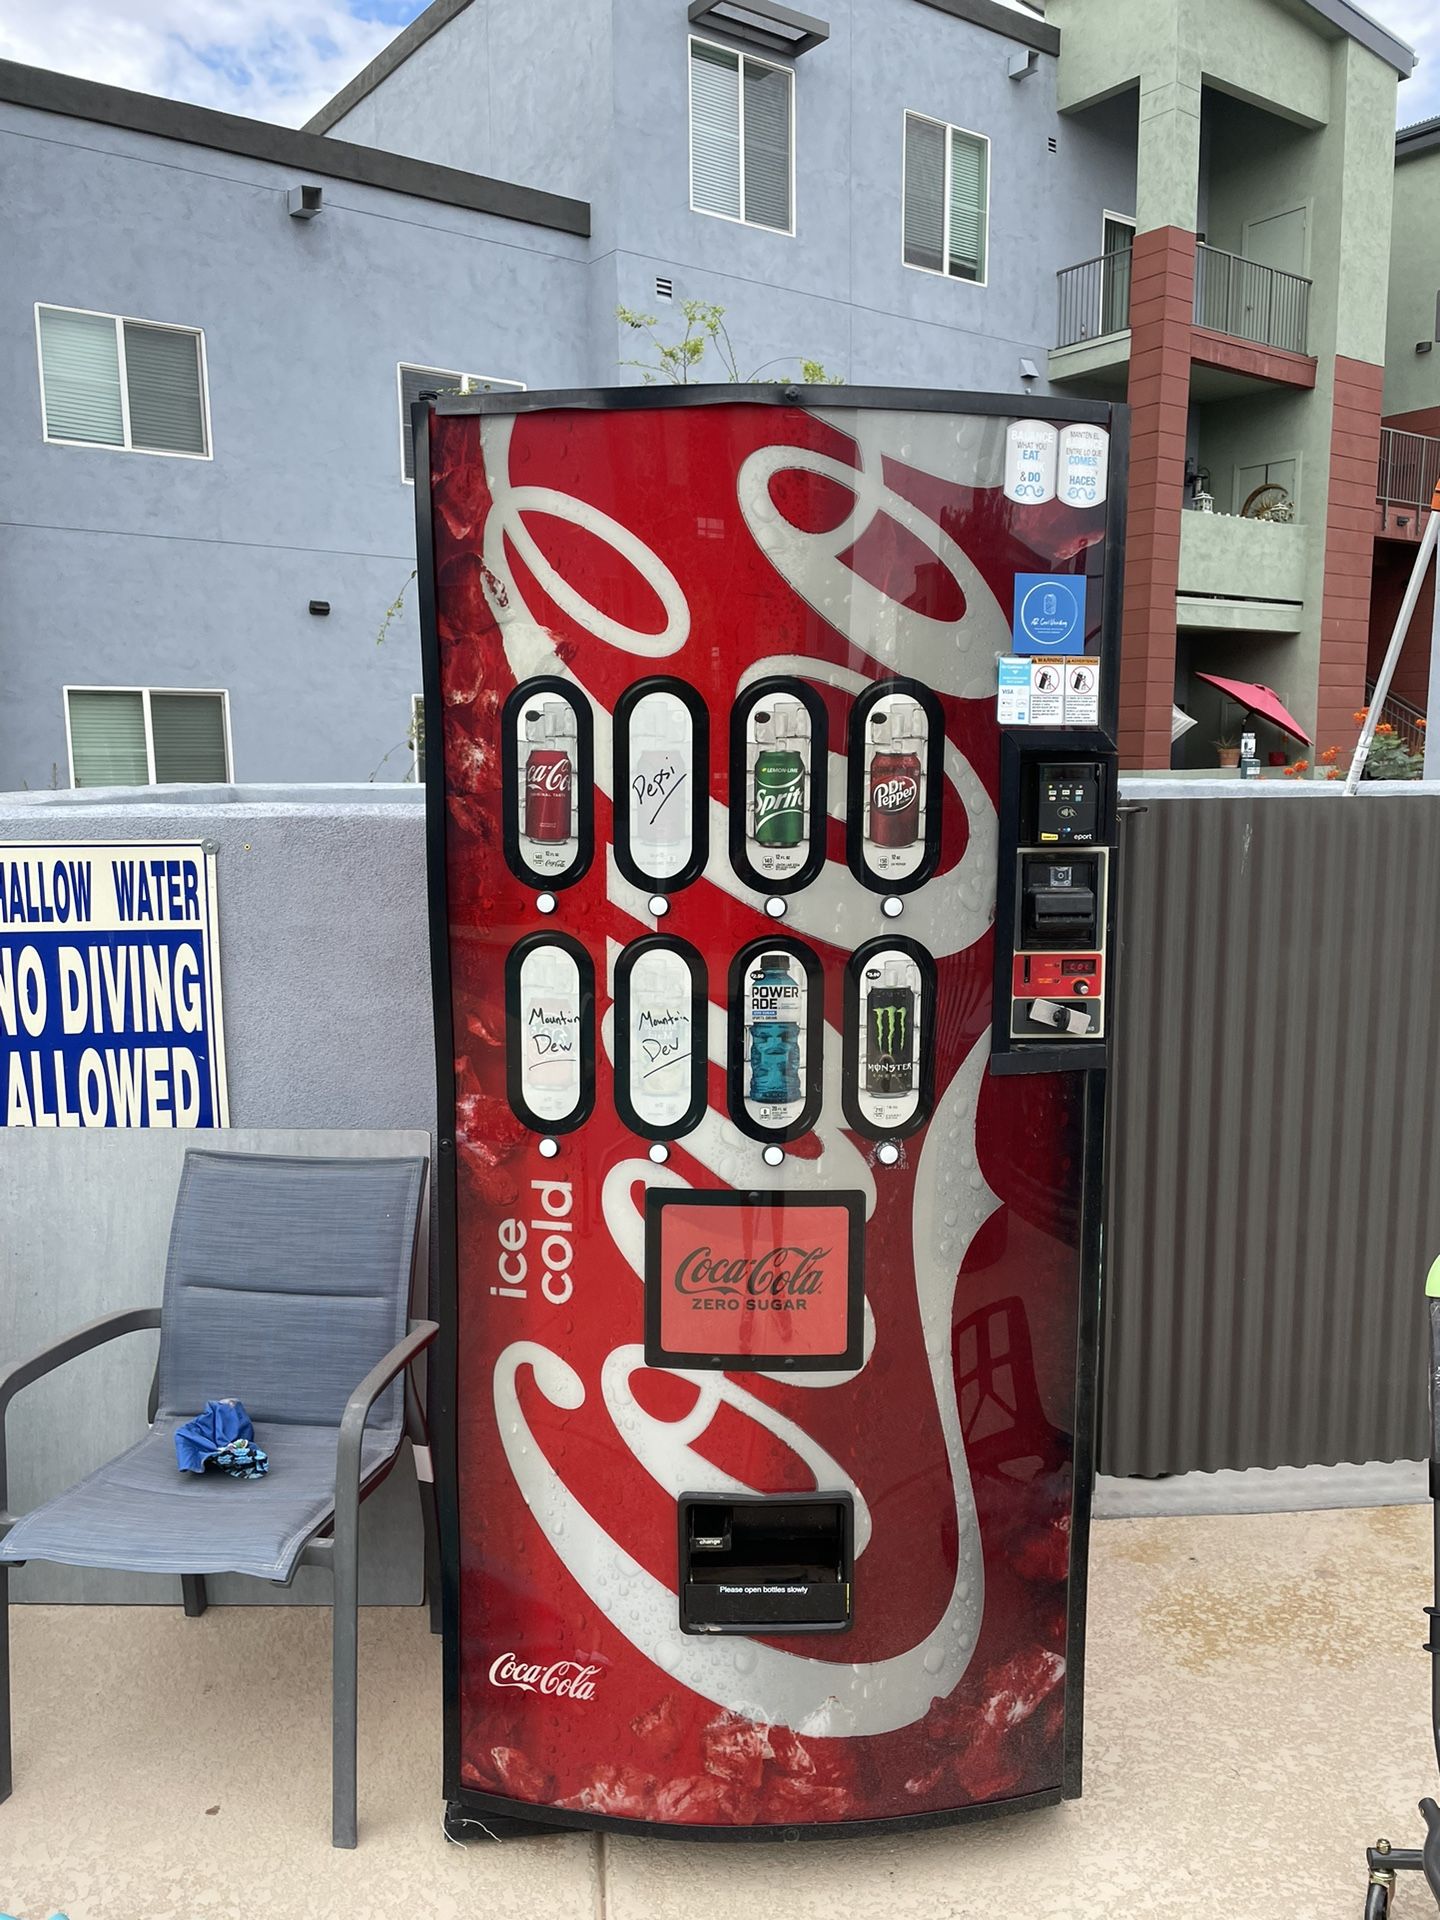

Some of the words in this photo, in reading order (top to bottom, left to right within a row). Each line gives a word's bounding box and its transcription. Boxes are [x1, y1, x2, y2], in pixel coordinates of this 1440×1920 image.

[1011, 429, 1054, 442] BALANCE
[1017, 441, 1034, 449] WHAT
[1035, 442, 1048, 450] YOU
[1068, 455, 1098, 466] COMES
[1020, 471, 1026, 482] &
[1028, 472, 1041, 482] DO
[1069, 475, 1096, 486] HACES
[632, 757, 675, 805] Pepsi
[888, 780, 906, 795] Dr
[877, 783, 915, 809] Pepper
[112, 860, 200, 922] WATER
[0, 945, 47, 1037] NO
[58, 943, 202, 1035] DIVING
[752, 986, 799, 998] POWER
[752, 998, 778, 1009] ADE
[532, 1034, 573, 1055] Dew
[868, 1062, 912, 1073] MONSTER
[7, 1047, 200, 1128] ALLOWED
[531, 1180, 573, 1304] cold
[490, 1218, 527, 1298] ice
[675, 1246, 833, 1297] Coca-Cola
[692, 1298, 740, 1311] ZERO
[745, 1298, 807, 1311] SUGAR
[699, 1538, 721, 1546] change
[720, 1585, 744, 1593] Please
[744, 1586, 762, 1594] open
[763, 1585, 786, 1593] bottles
[787, 1586, 809, 1595] slowly
[488, 1651, 602, 1701] Coca-Cola
